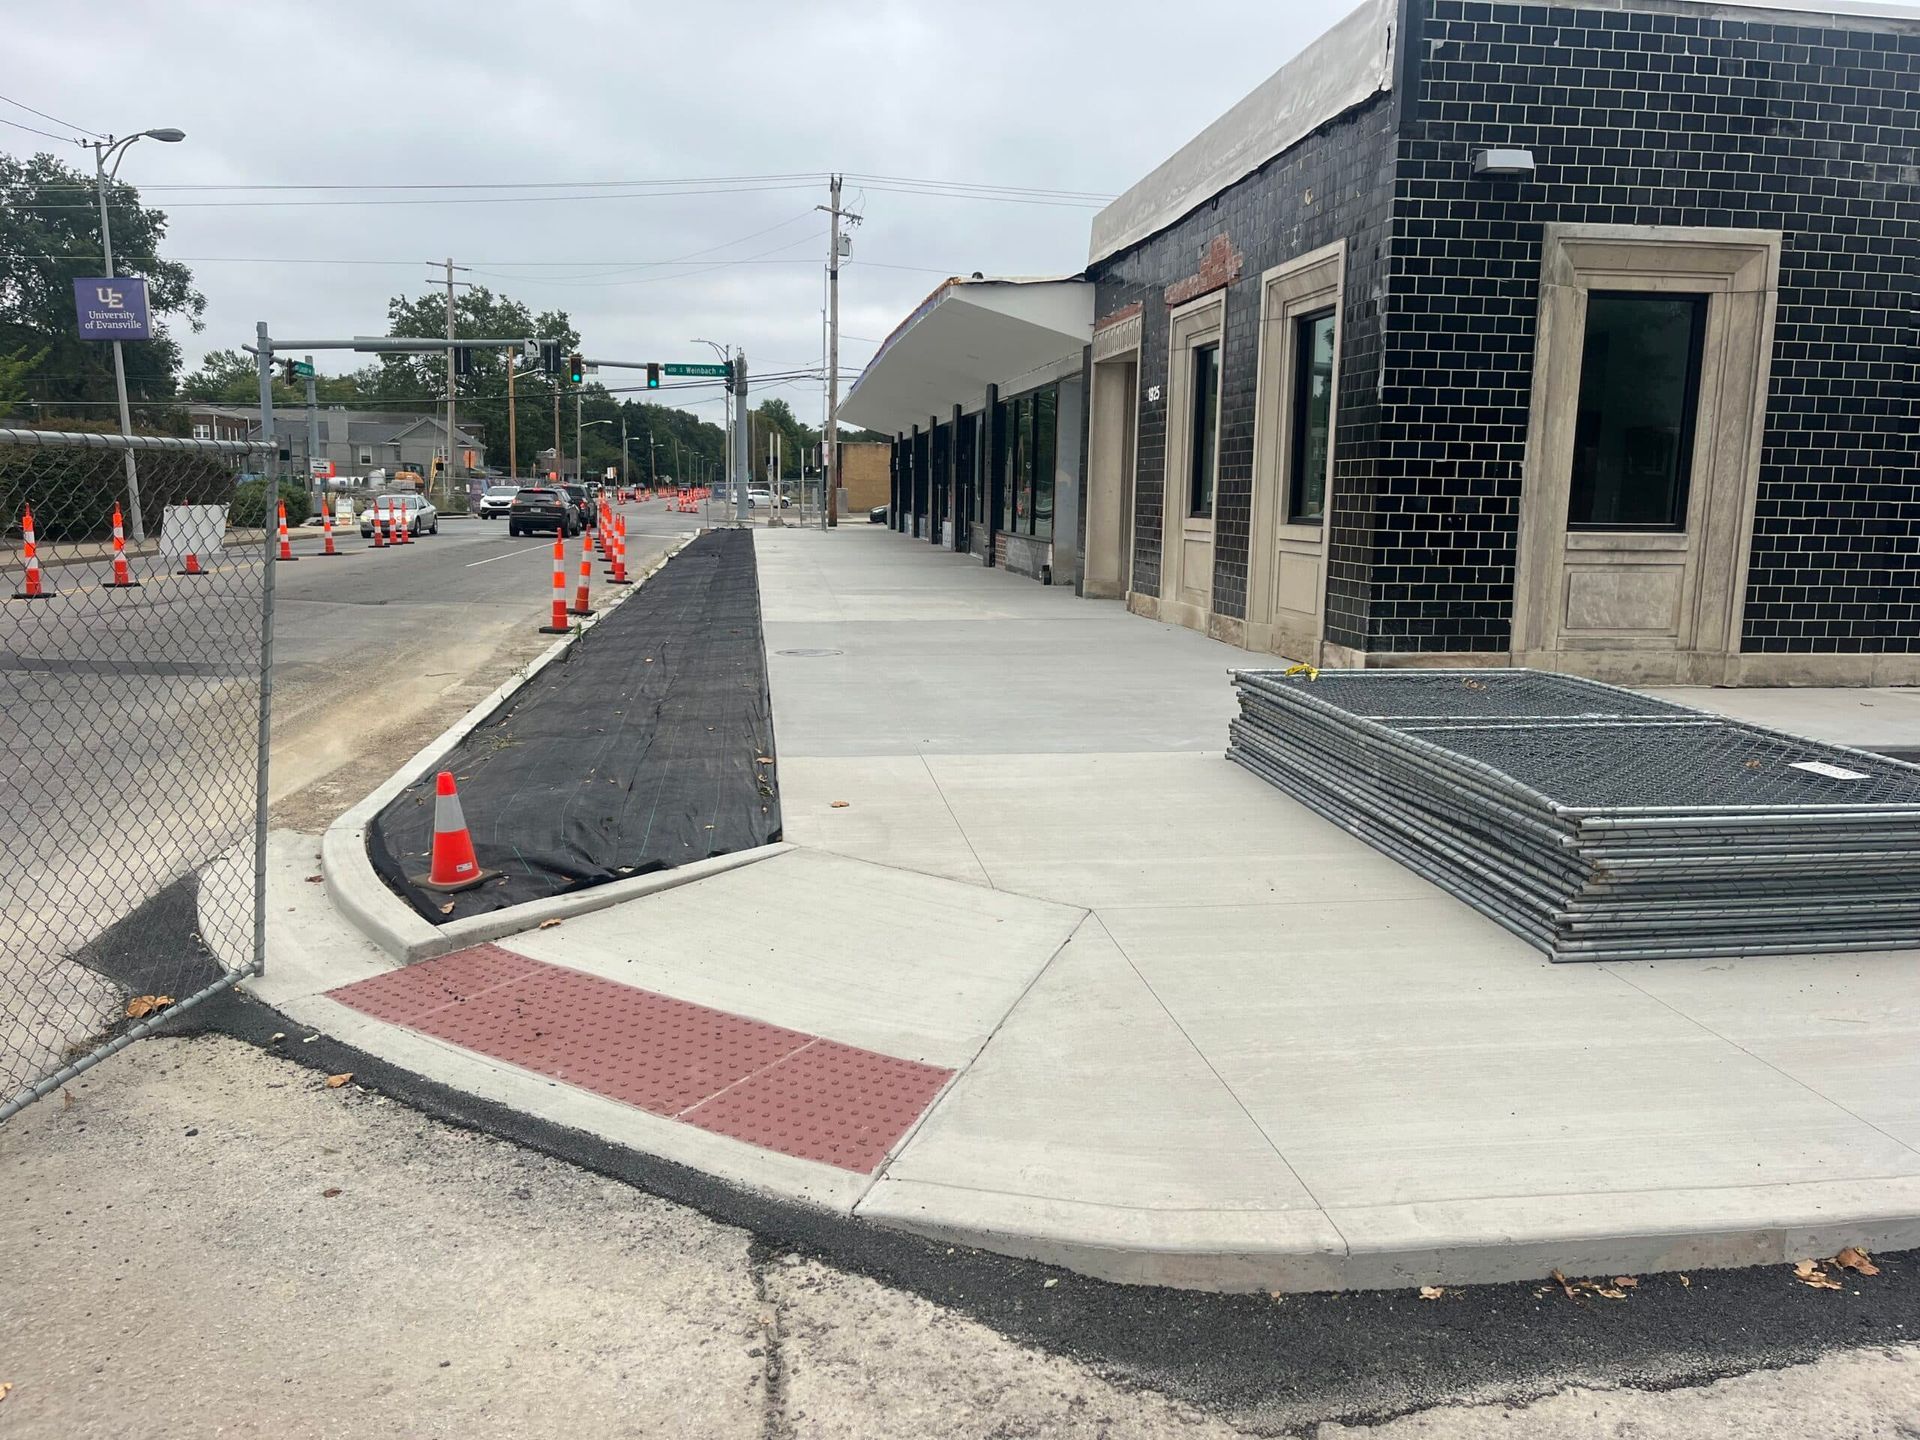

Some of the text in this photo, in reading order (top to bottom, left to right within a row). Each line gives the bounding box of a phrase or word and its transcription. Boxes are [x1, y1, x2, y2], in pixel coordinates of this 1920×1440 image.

[96, 287, 124, 309] UE
[88, 310, 135, 320] University
[84, 320, 142, 329] of Evansville
[685, 366, 717, 375] Weinbach
